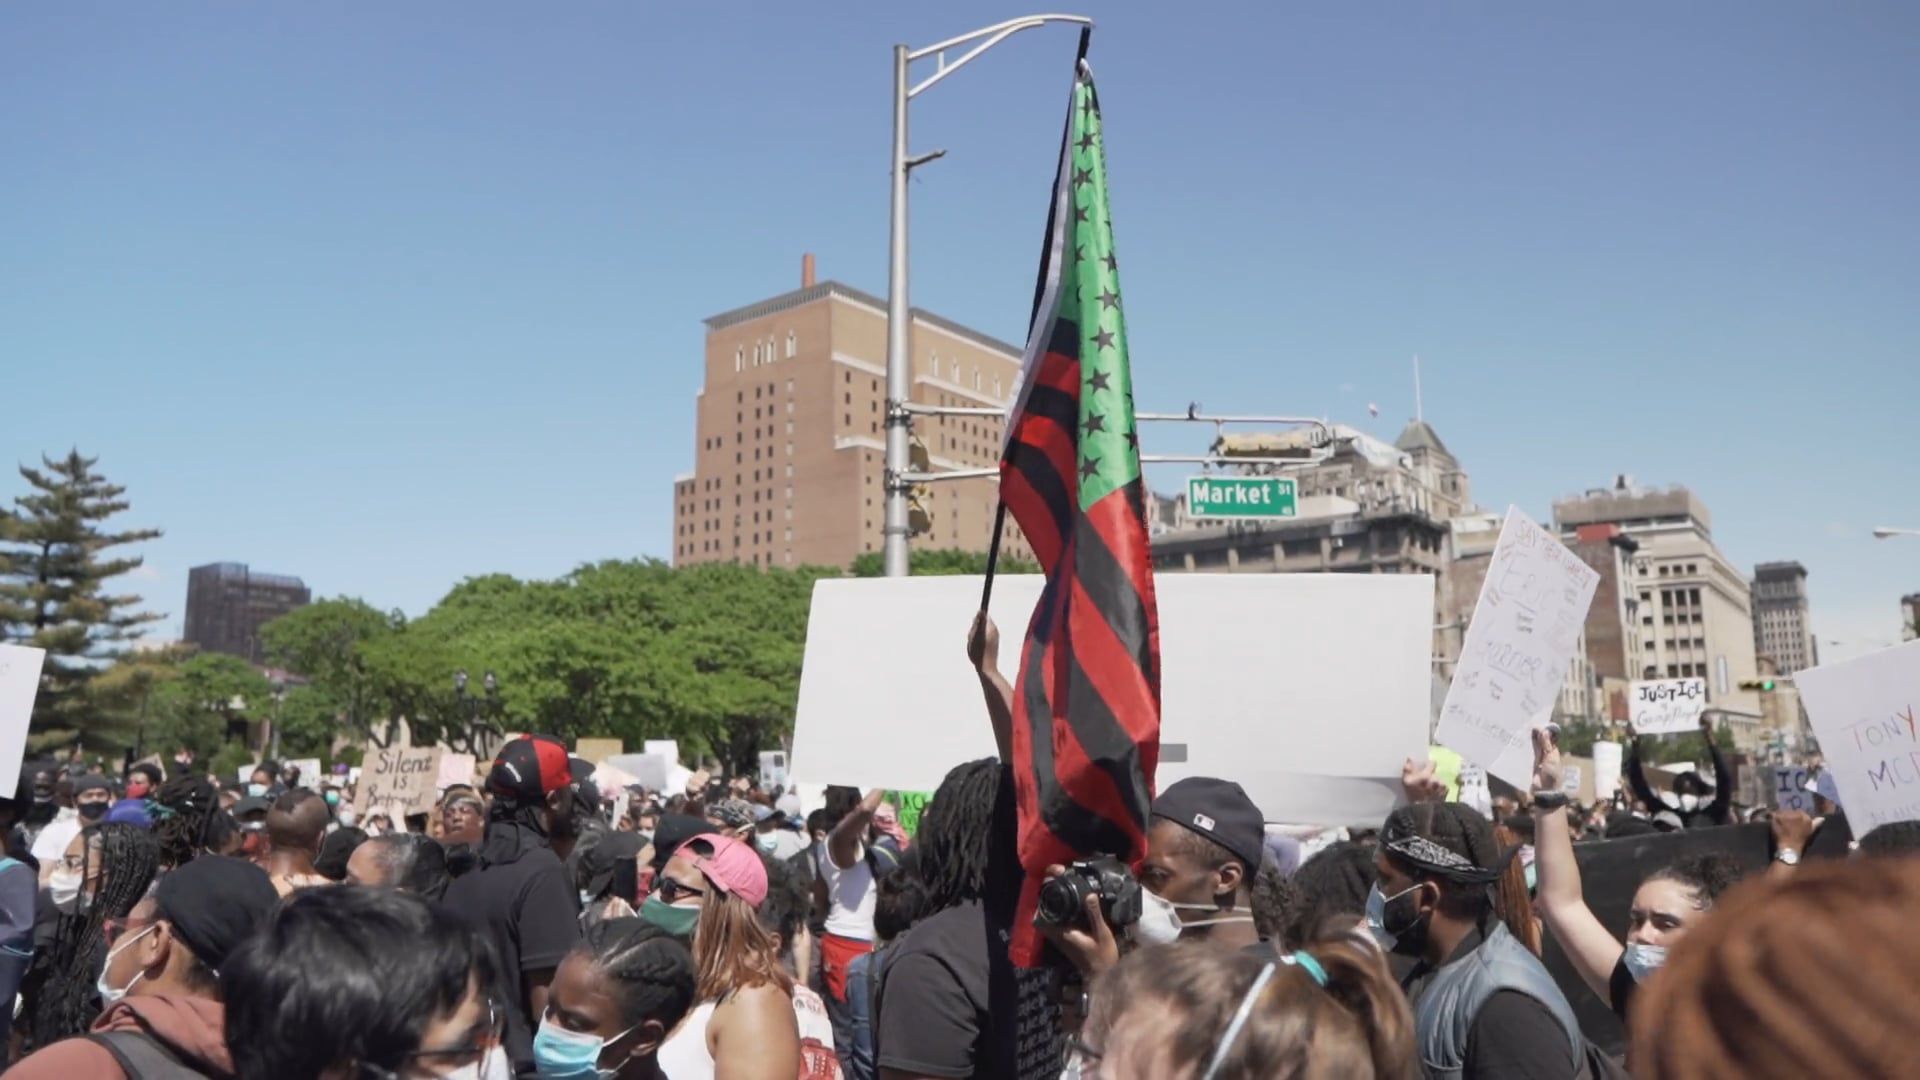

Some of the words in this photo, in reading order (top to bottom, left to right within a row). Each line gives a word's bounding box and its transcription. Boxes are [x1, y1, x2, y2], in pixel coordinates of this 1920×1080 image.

[1192, 482, 1271, 504] Market
[1278, 483, 1291, 495] St
[1842, 704, 1917, 752] TONY
[376, 750, 432, 774] Silent
